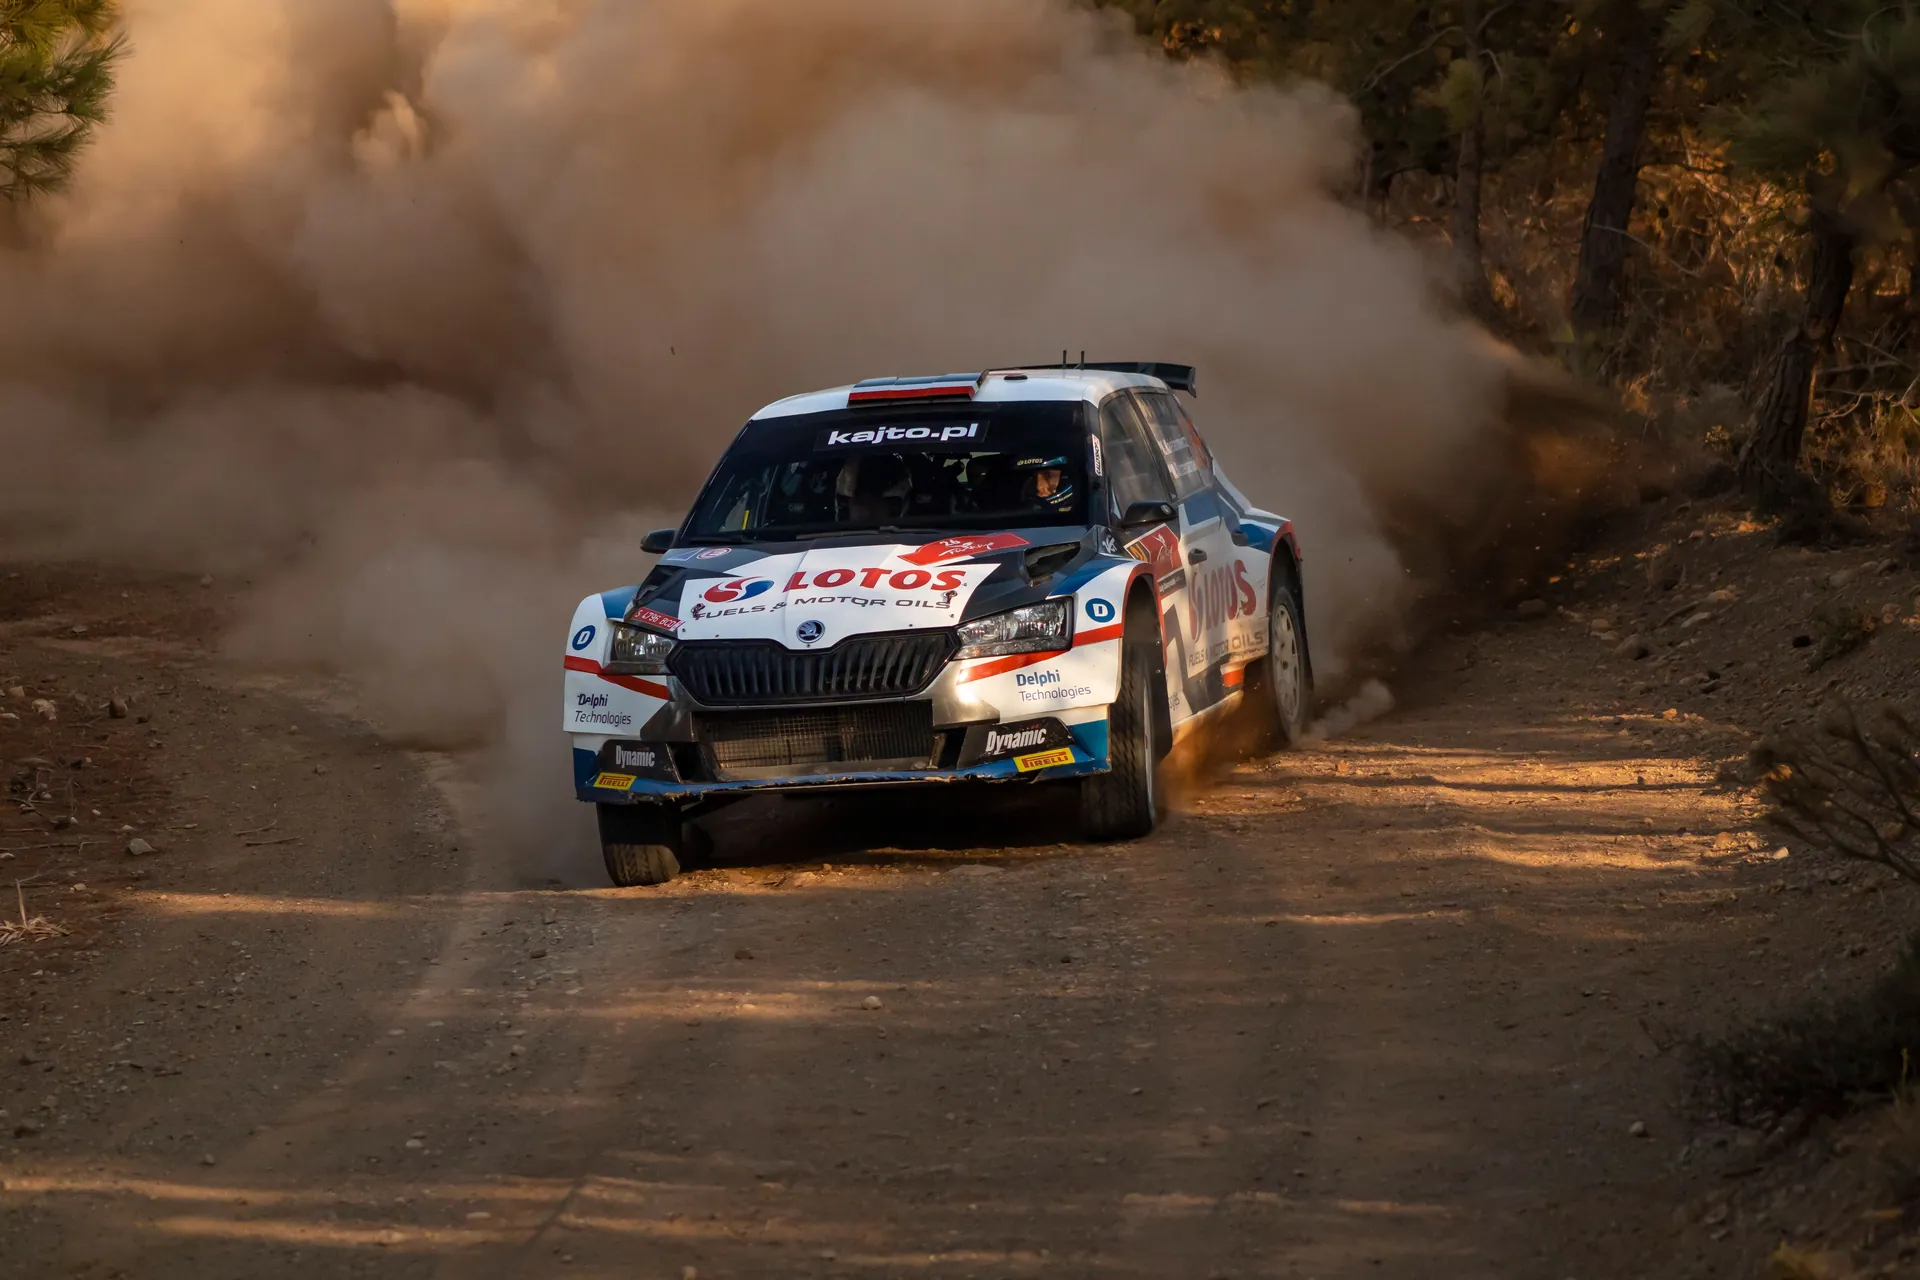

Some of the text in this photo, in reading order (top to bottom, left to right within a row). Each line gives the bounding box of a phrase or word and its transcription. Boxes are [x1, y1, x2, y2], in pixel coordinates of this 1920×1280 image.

[828, 422, 979, 445] kajto.pl
[784, 567, 967, 592] LOTOS
[1204, 559, 1257, 631] LOTOS
[694, 605, 766, 620] FUELS
[794, 596, 886, 607] MOTOR
[895, 600, 950, 609] OILS
[1231, 632, 1263, 650] OILS
[1016, 669, 1061, 686] Delphi
[578, 693, 608, 709] Delphi
[1019, 685, 1092, 702] Technologies
[575, 710, 631, 727] Technologies
[986, 728, 1047, 755] Dynamic
[616, 745, 655, 769] Dynamic
[1021, 751, 1069, 768] PIRELLI
[599, 776, 632, 788] PIRELLI
